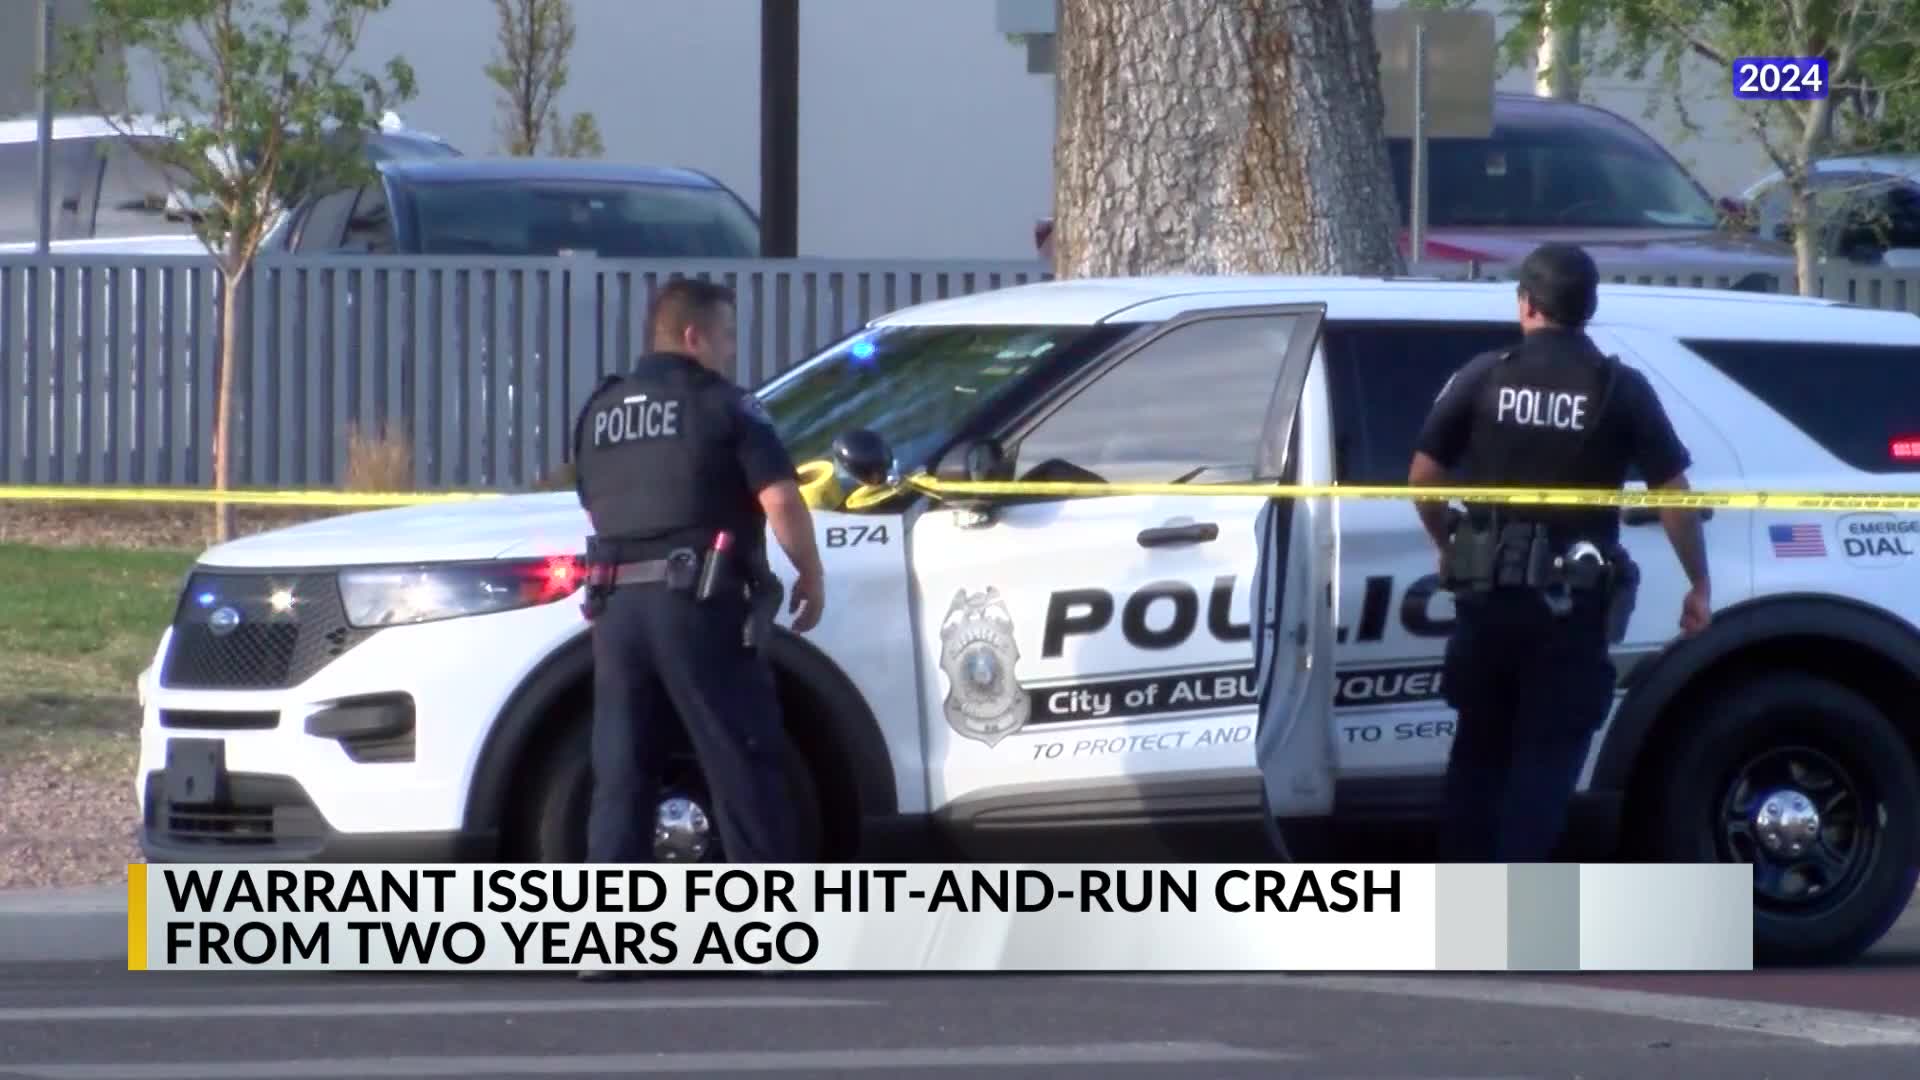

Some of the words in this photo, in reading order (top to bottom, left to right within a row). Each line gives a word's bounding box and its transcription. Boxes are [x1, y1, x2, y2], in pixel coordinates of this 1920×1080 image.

[594, 400, 679, 446] POLICE
[1497, 387, 1588, 431] POLICE
[826, 525, 890, 549] B74
[1848, 520, 1920, 536] EMERGE
[1843, 537, 1914, 558] DIAL
[1047, 689, 1112, 716] City
[1124, 683, 1160, 708] of
[1032, 742, 1065, 761] TO
[1072, 730, 1191, 758] PROTECT
[1194, 726, 1252, 748] AND
[1343, 725, 1382, 744] TO
[1394, 720, 1457, 741] SER
